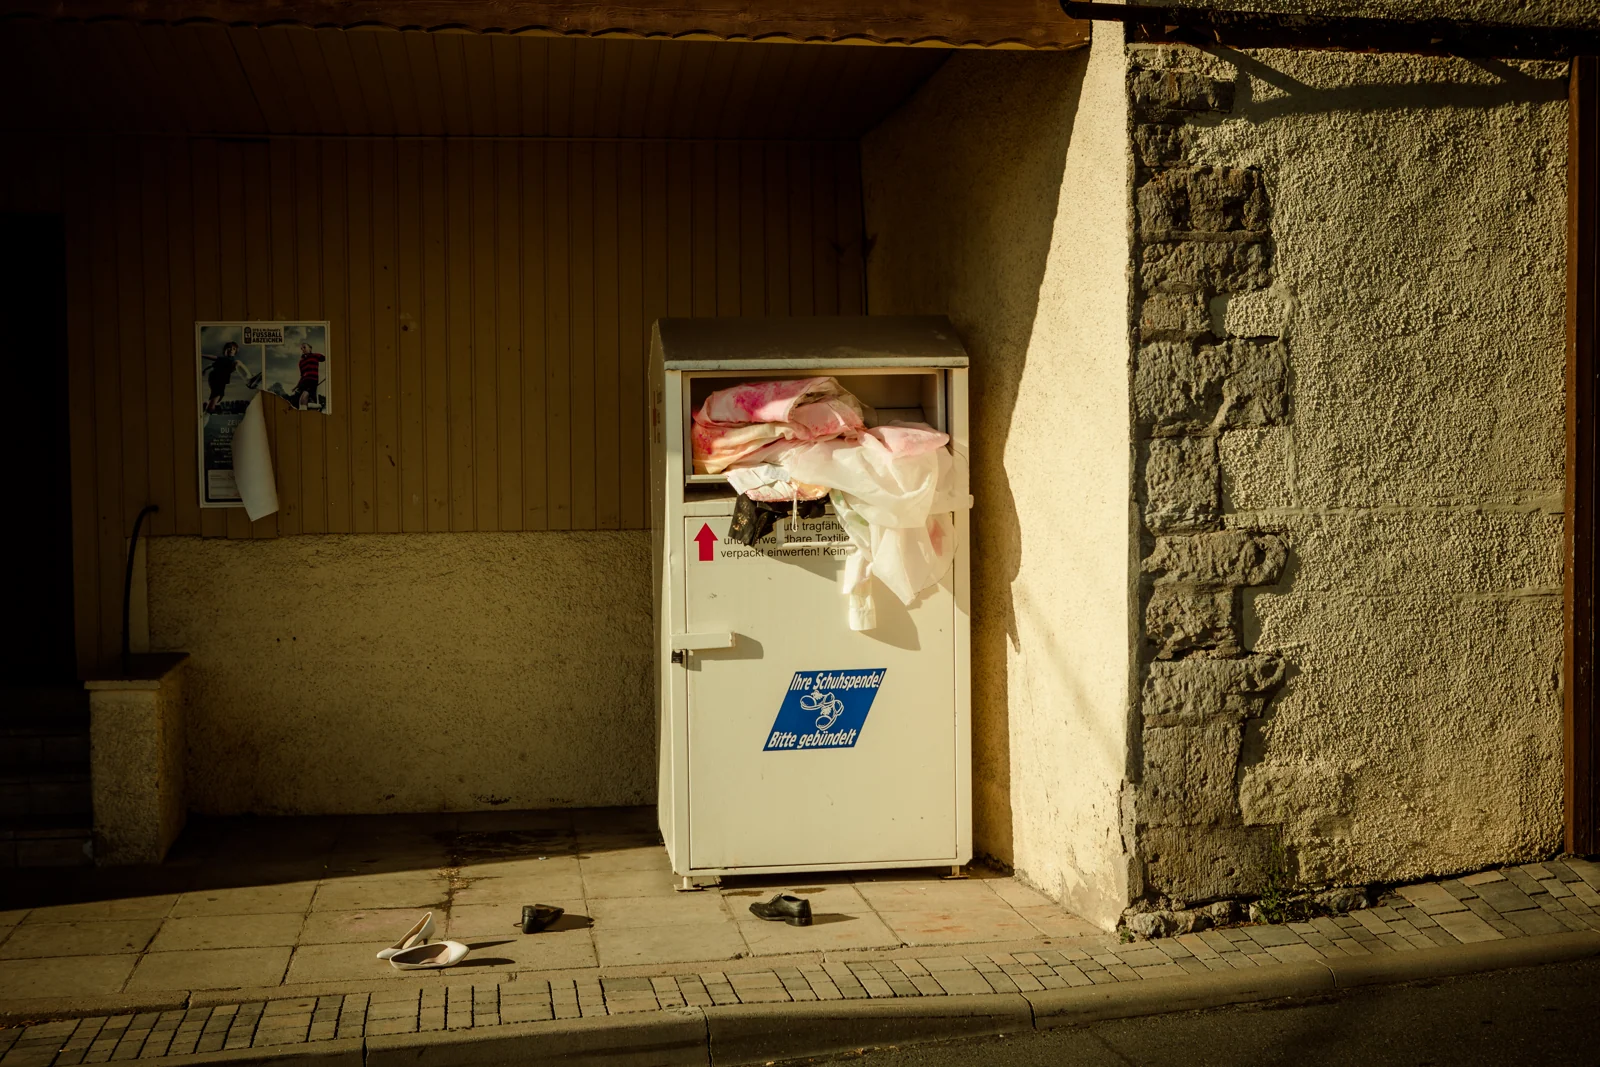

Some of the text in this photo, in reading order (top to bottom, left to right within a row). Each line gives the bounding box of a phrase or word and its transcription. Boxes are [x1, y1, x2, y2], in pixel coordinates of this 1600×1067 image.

[784, 521, 799, 531] ute
[720, 547, 848, 559] verpackt einwerfen! Kein
[789, 671, 885, 691] Ihre Schuhspende!
[767, 728, 857, 749] Bitte gebündelt
